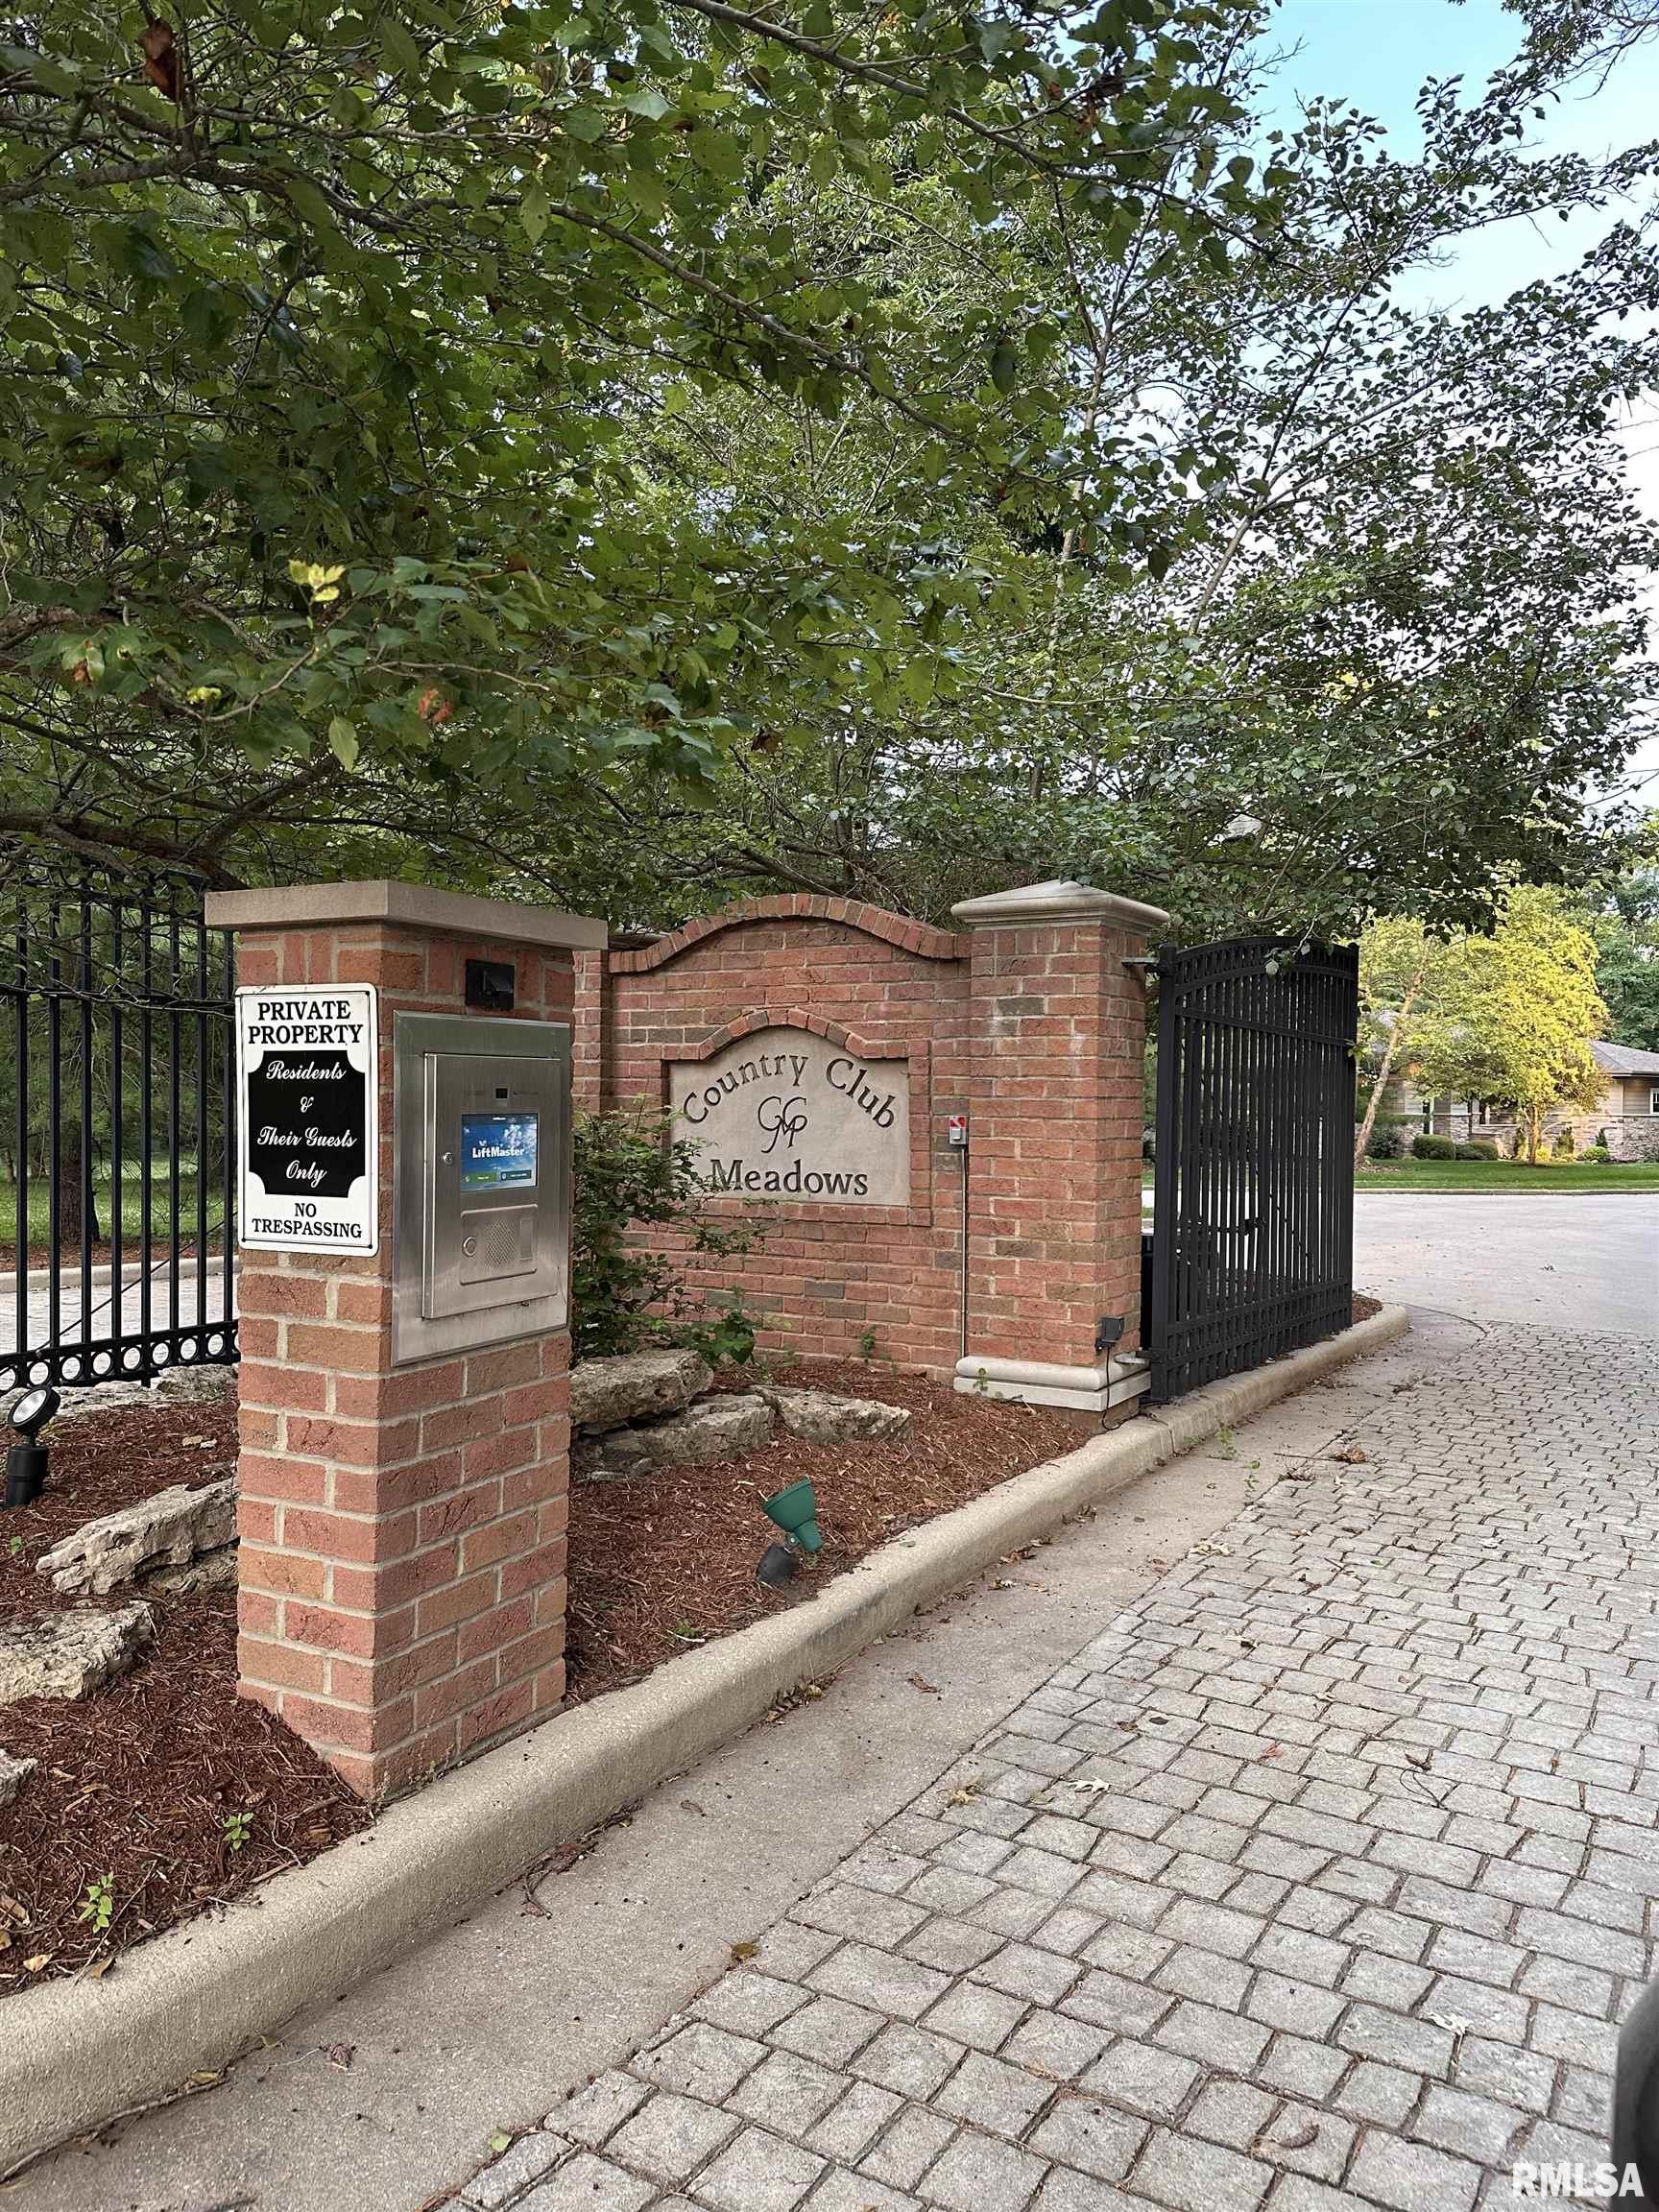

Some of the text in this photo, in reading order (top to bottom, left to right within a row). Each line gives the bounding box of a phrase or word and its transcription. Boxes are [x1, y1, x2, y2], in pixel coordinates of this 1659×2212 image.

[257, 1000, 350, 1021] PRIVATE
[248, 1024, 363, 1045] PROPERTY
[266, 1060, 347, 1080] Residents
[683, 1053, 896, 1128] Country Club
[300, 1096, 314, 1113] &
[256, 1125, 357, 1147] Their Guests
[471, 1146, 525, 1159] LiftMaster
[285, 1160, 327, 1189] Only
[709, 1159, 869, 1196] Meadows
[294, 1202, 317, 1217] NO
[252, 1217, 363, 1238] TRESPASSING
